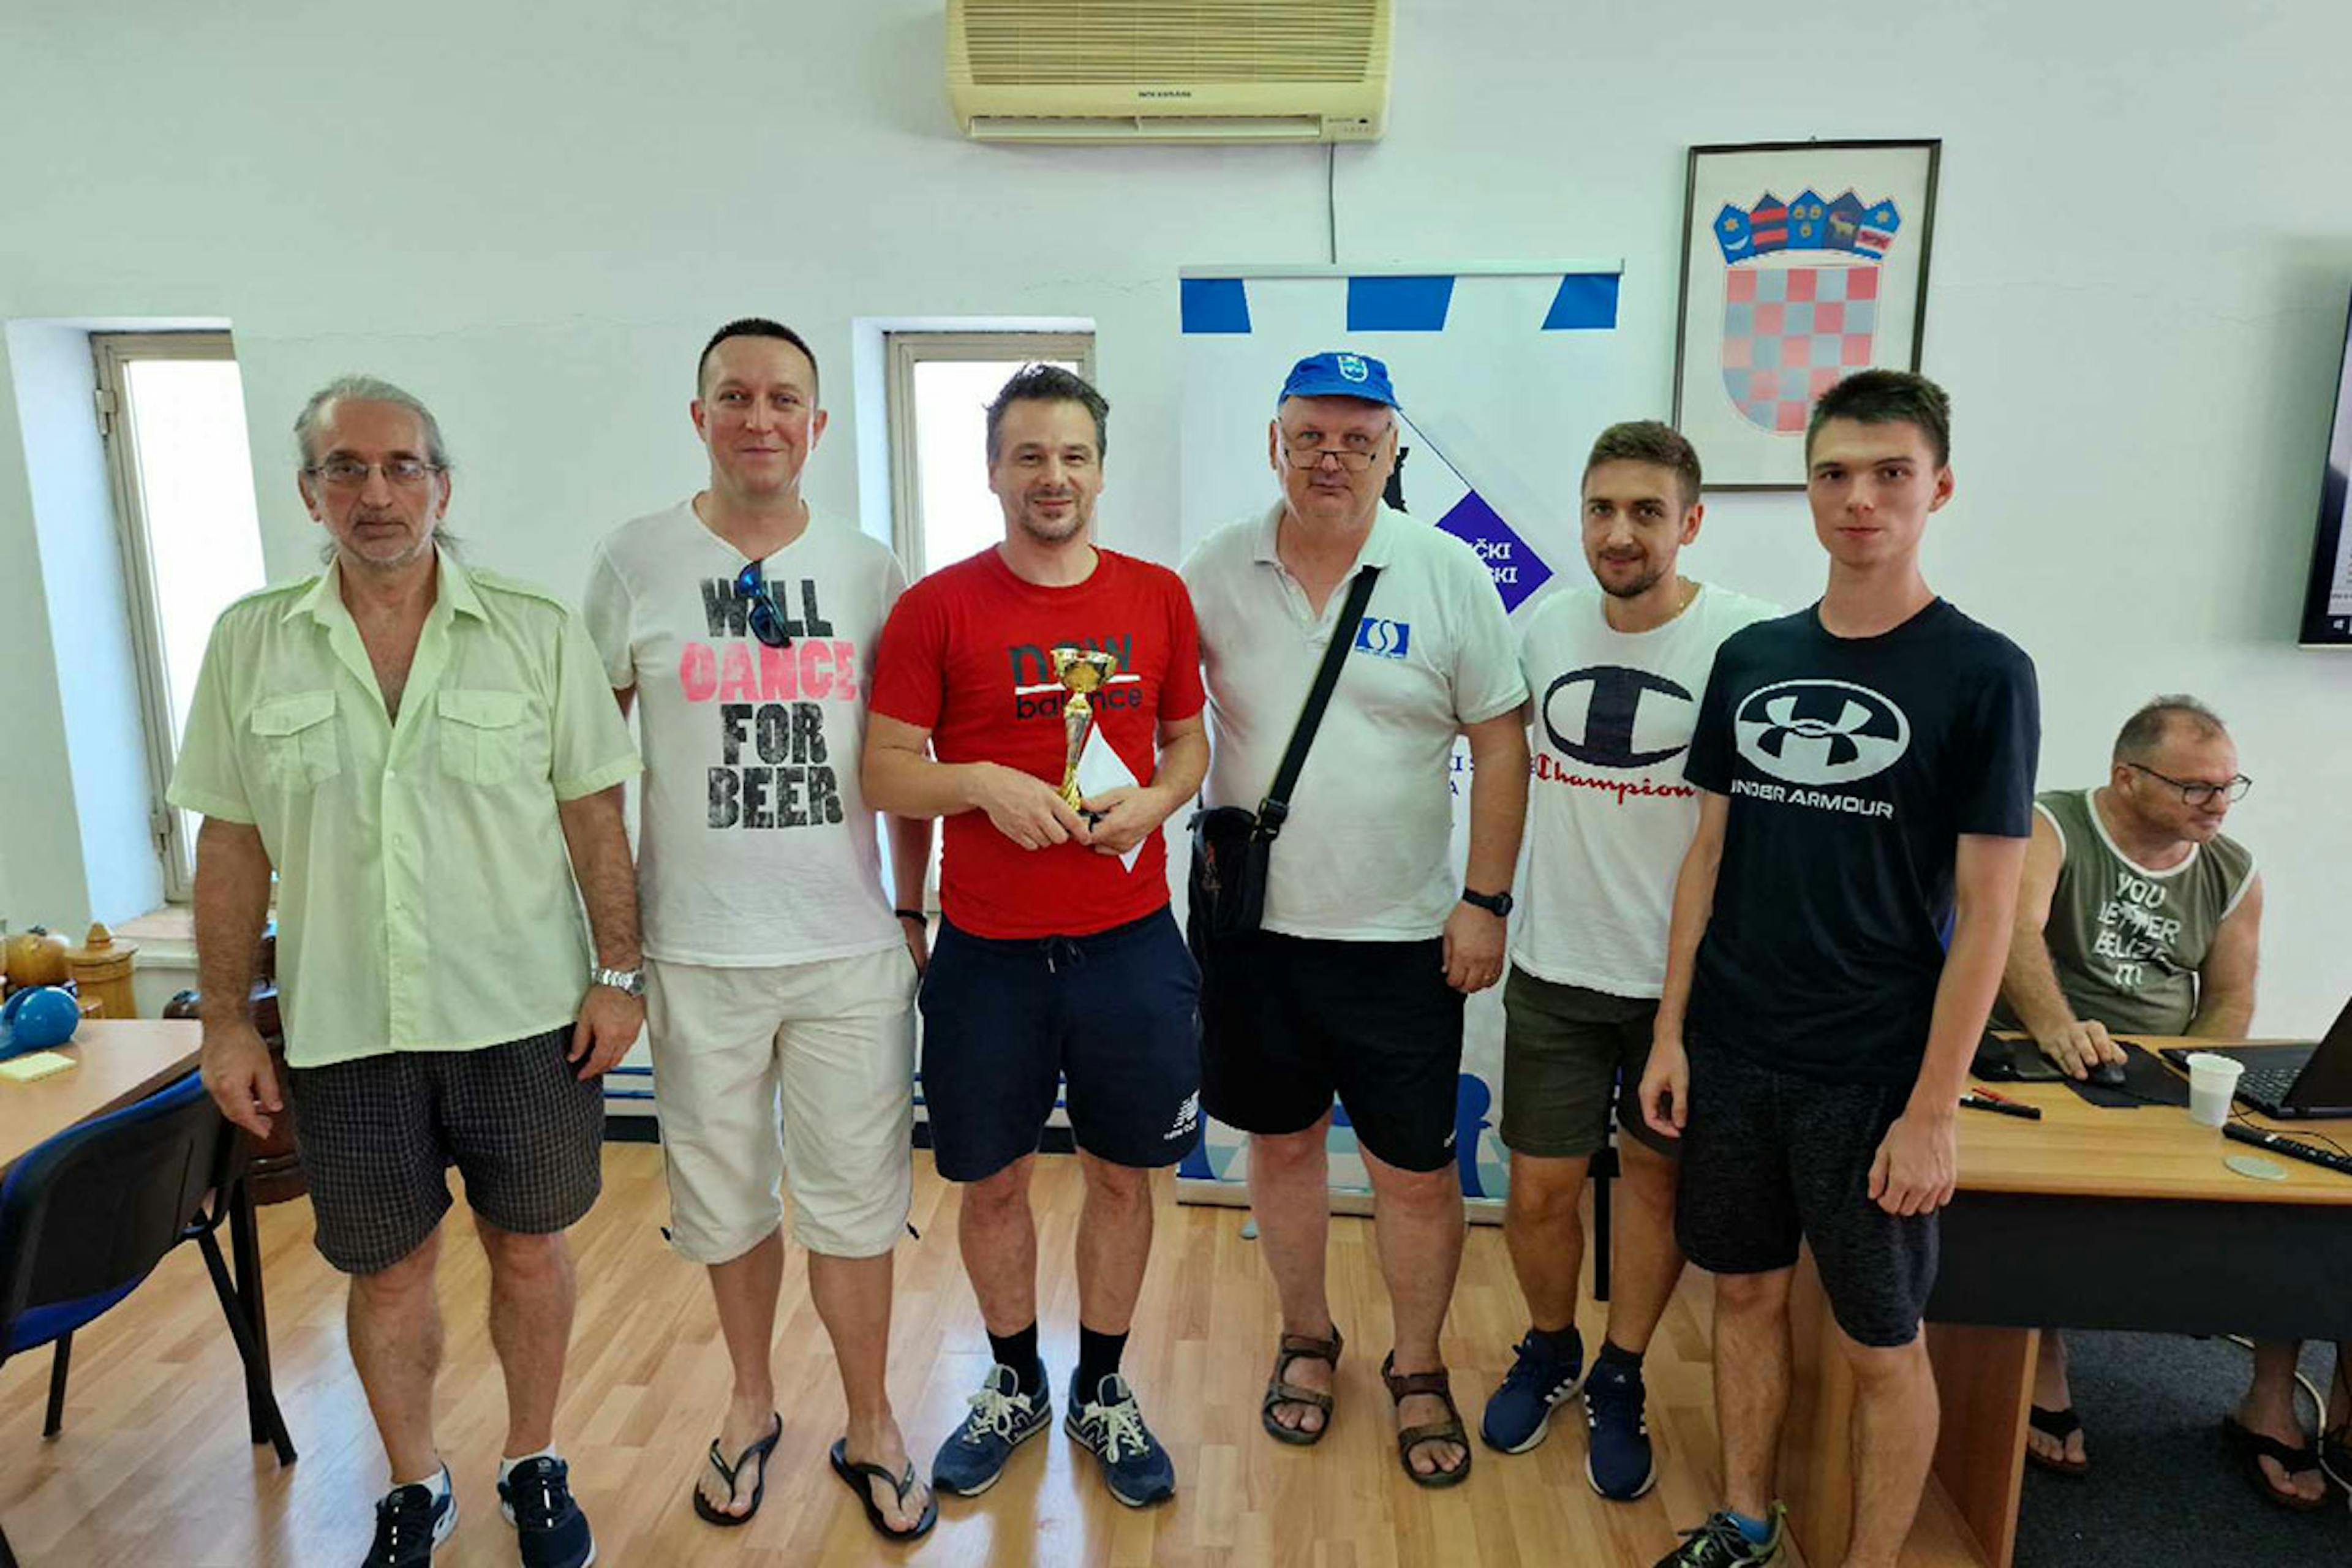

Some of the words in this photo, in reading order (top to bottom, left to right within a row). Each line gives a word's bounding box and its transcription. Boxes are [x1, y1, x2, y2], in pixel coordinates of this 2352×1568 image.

[1473, 537, 1512, 560] ČKI
[700, 578, 834, 638] WLL
[680, 639, 858, 702] DANCE
[1007, 633, 1132, 685] nw
[1016, 686, 1143, 720] balnce
[720, 703, 827, 765] FOR
[707, 766, 843, 829] BEER
[1536, 753, 1695, 805] Champion
[1787, 788, 1894, 820] ARMOUR
[2116, 873, 2166, 908] YOU
